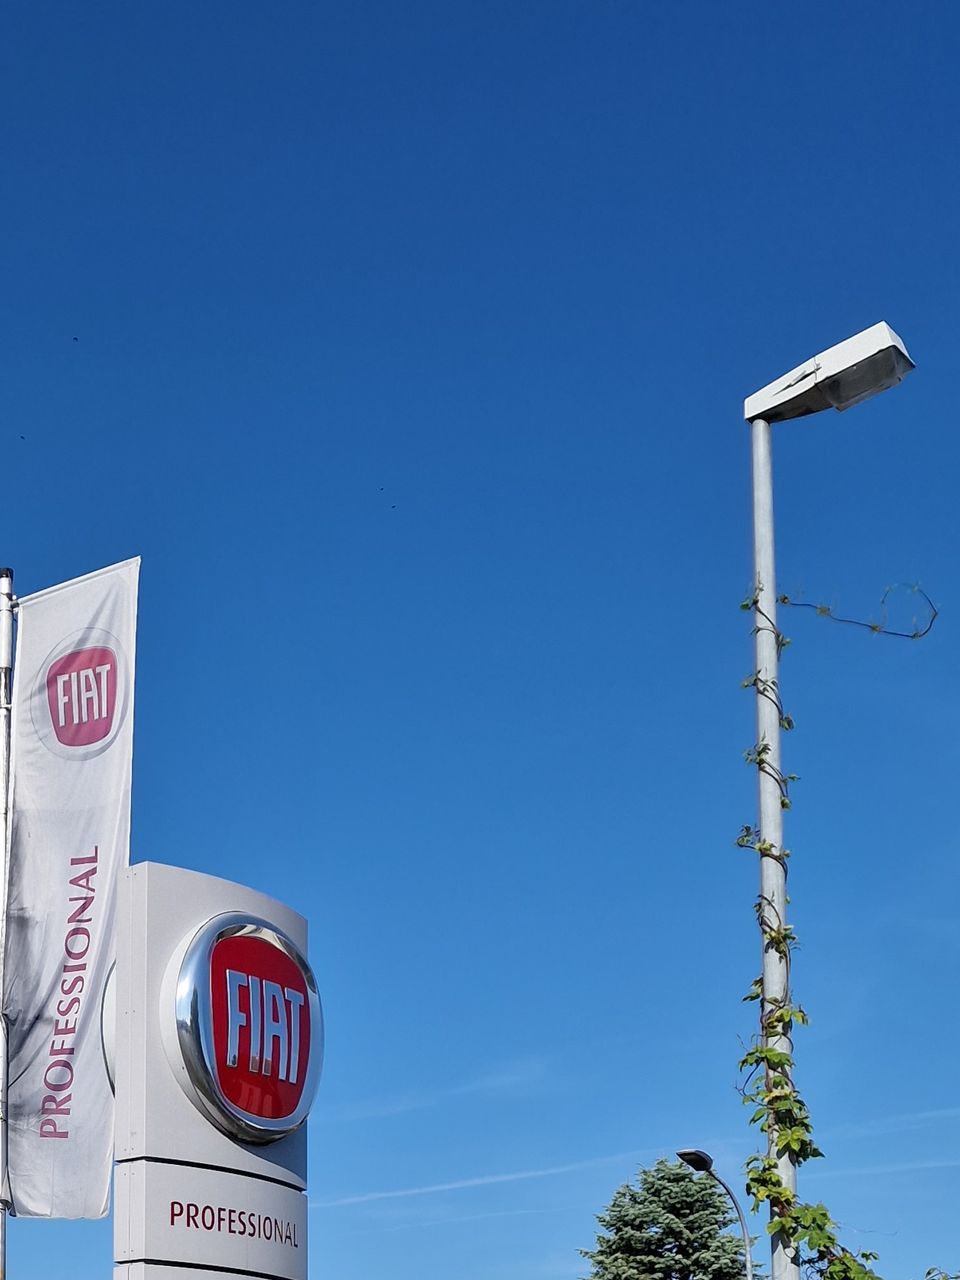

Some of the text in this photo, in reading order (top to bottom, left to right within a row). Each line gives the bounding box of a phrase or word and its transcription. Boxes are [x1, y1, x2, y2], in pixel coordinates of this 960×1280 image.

[56, 664, 111, 728] FIAT
[40, 845, 98, 1139] PROFESSIONAL
[226, 969, 304, 1085] FIAT
[169, 1201, 299, 1249] PROFESSIONAL
